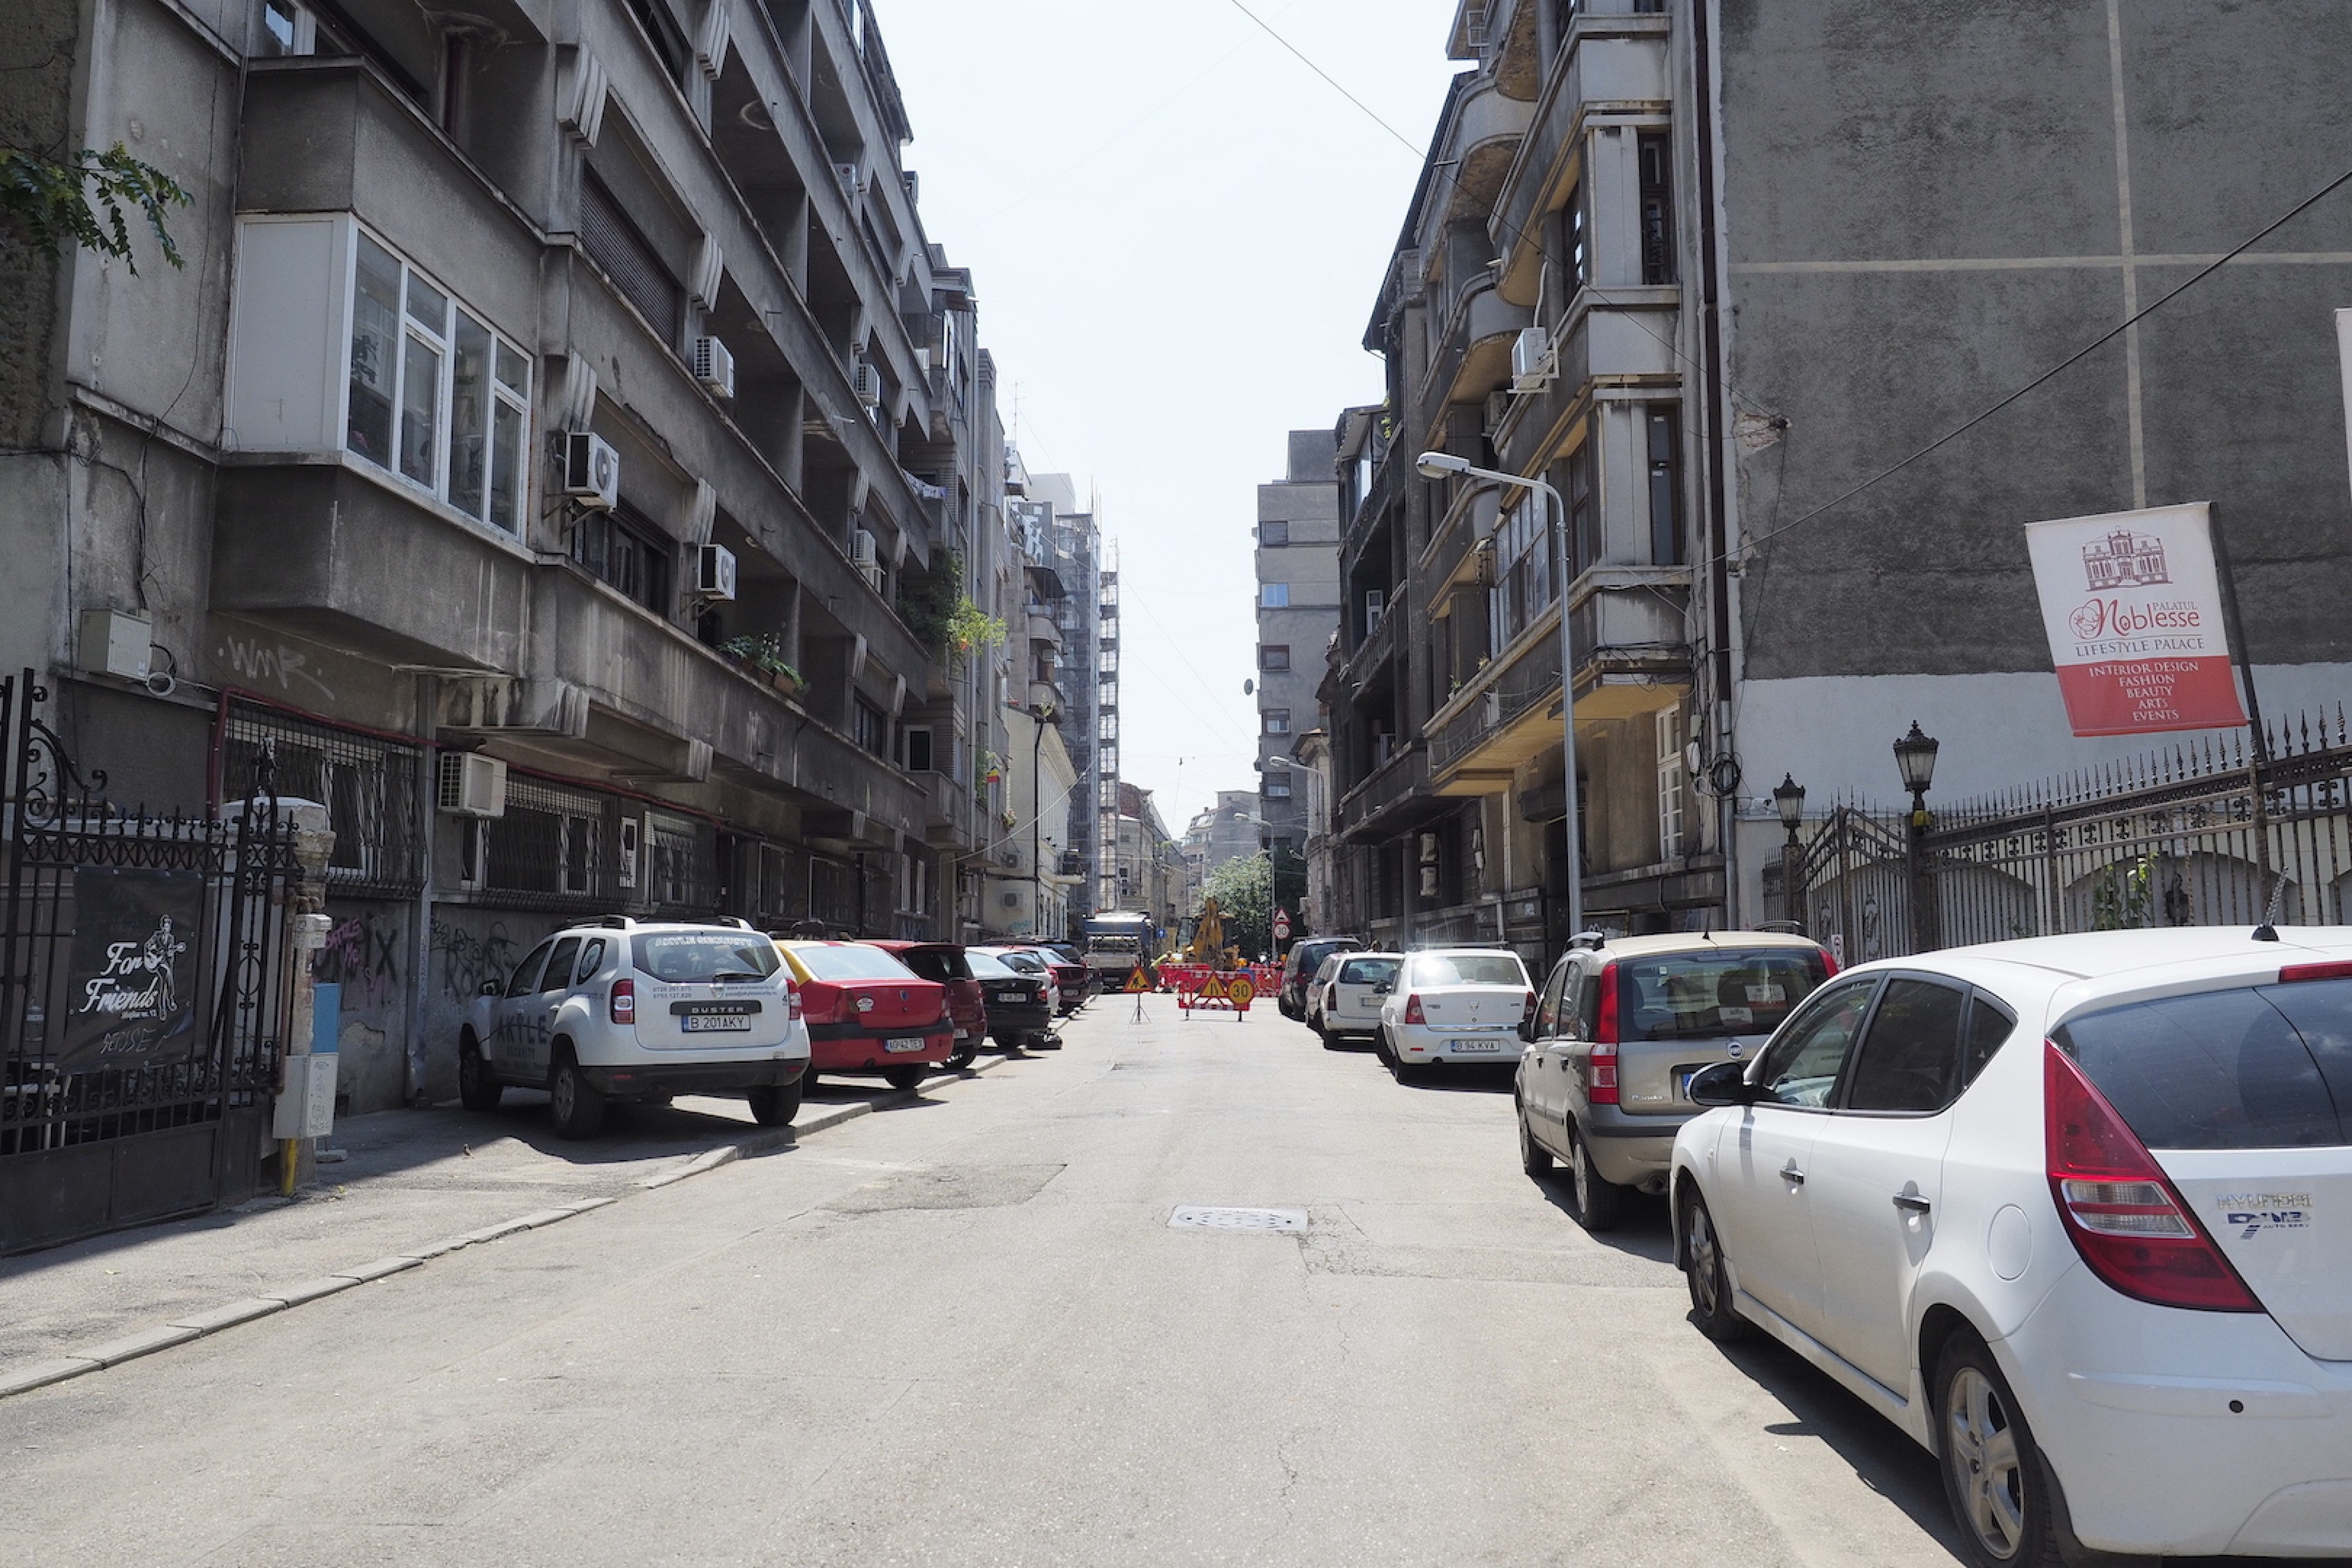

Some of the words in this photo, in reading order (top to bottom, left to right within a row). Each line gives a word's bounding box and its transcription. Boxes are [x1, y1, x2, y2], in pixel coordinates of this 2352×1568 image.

[2152, 601, 2198, 611] PALATUL
[2070, 598, 2200, 639] Noblesse
[2076, 640, 2150, 657] LIFESTYLE
[2154, 638, 2205, 651] PALACE
[2089, 663, 2152, 677] INTERIOR
[2154, 662, 2199, 673] DESIGN
[2119, 674, 2175, 687] FASHION
[2127, 685, 2173, 699] BEAUTY
[2138, 698, 2169, 710] ARTS
[2132, 709, 2180, 722] EVENTS
[100, 941, 143, 976] For
[79, 976, 159, 1012] Friends
[1234, 984, 1249, 998] 30
[497, 1014, 547, 1044] AKYLE
[691, 1017, 699, 1028] B
[2216, 1193, 2313, 1210] HYUNDAI
